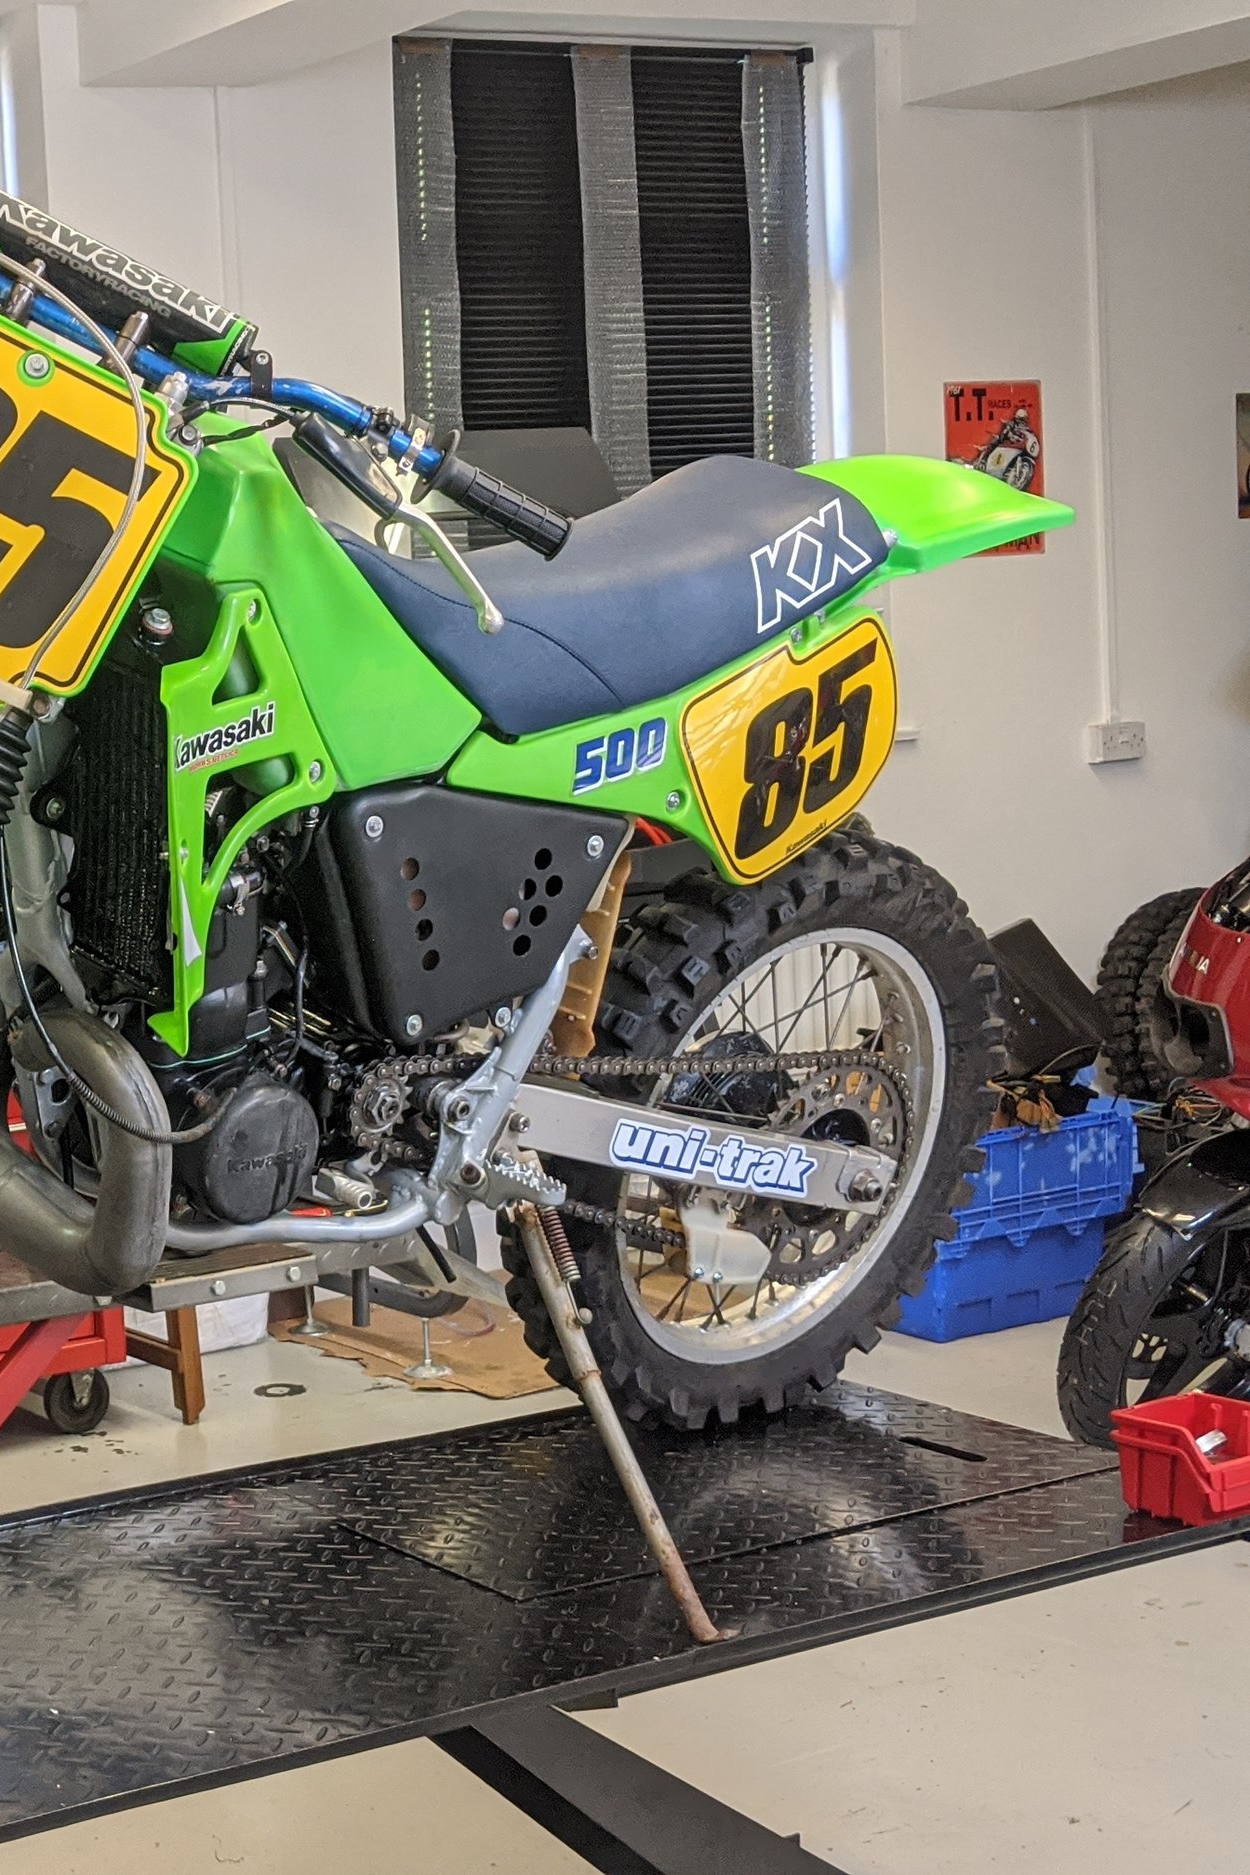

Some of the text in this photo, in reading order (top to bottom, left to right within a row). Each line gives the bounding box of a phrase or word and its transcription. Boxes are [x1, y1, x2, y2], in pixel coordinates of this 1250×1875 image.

[989, 399, 1013, 409] RACES
[749, 497, 873, 634] KX
[573, 716, 668, 796] 500
[734, 636, 879, 861] 85
[785, 817, 827, 855] Kawasaki
[611, 1122, 816, 1193] uni-trak
